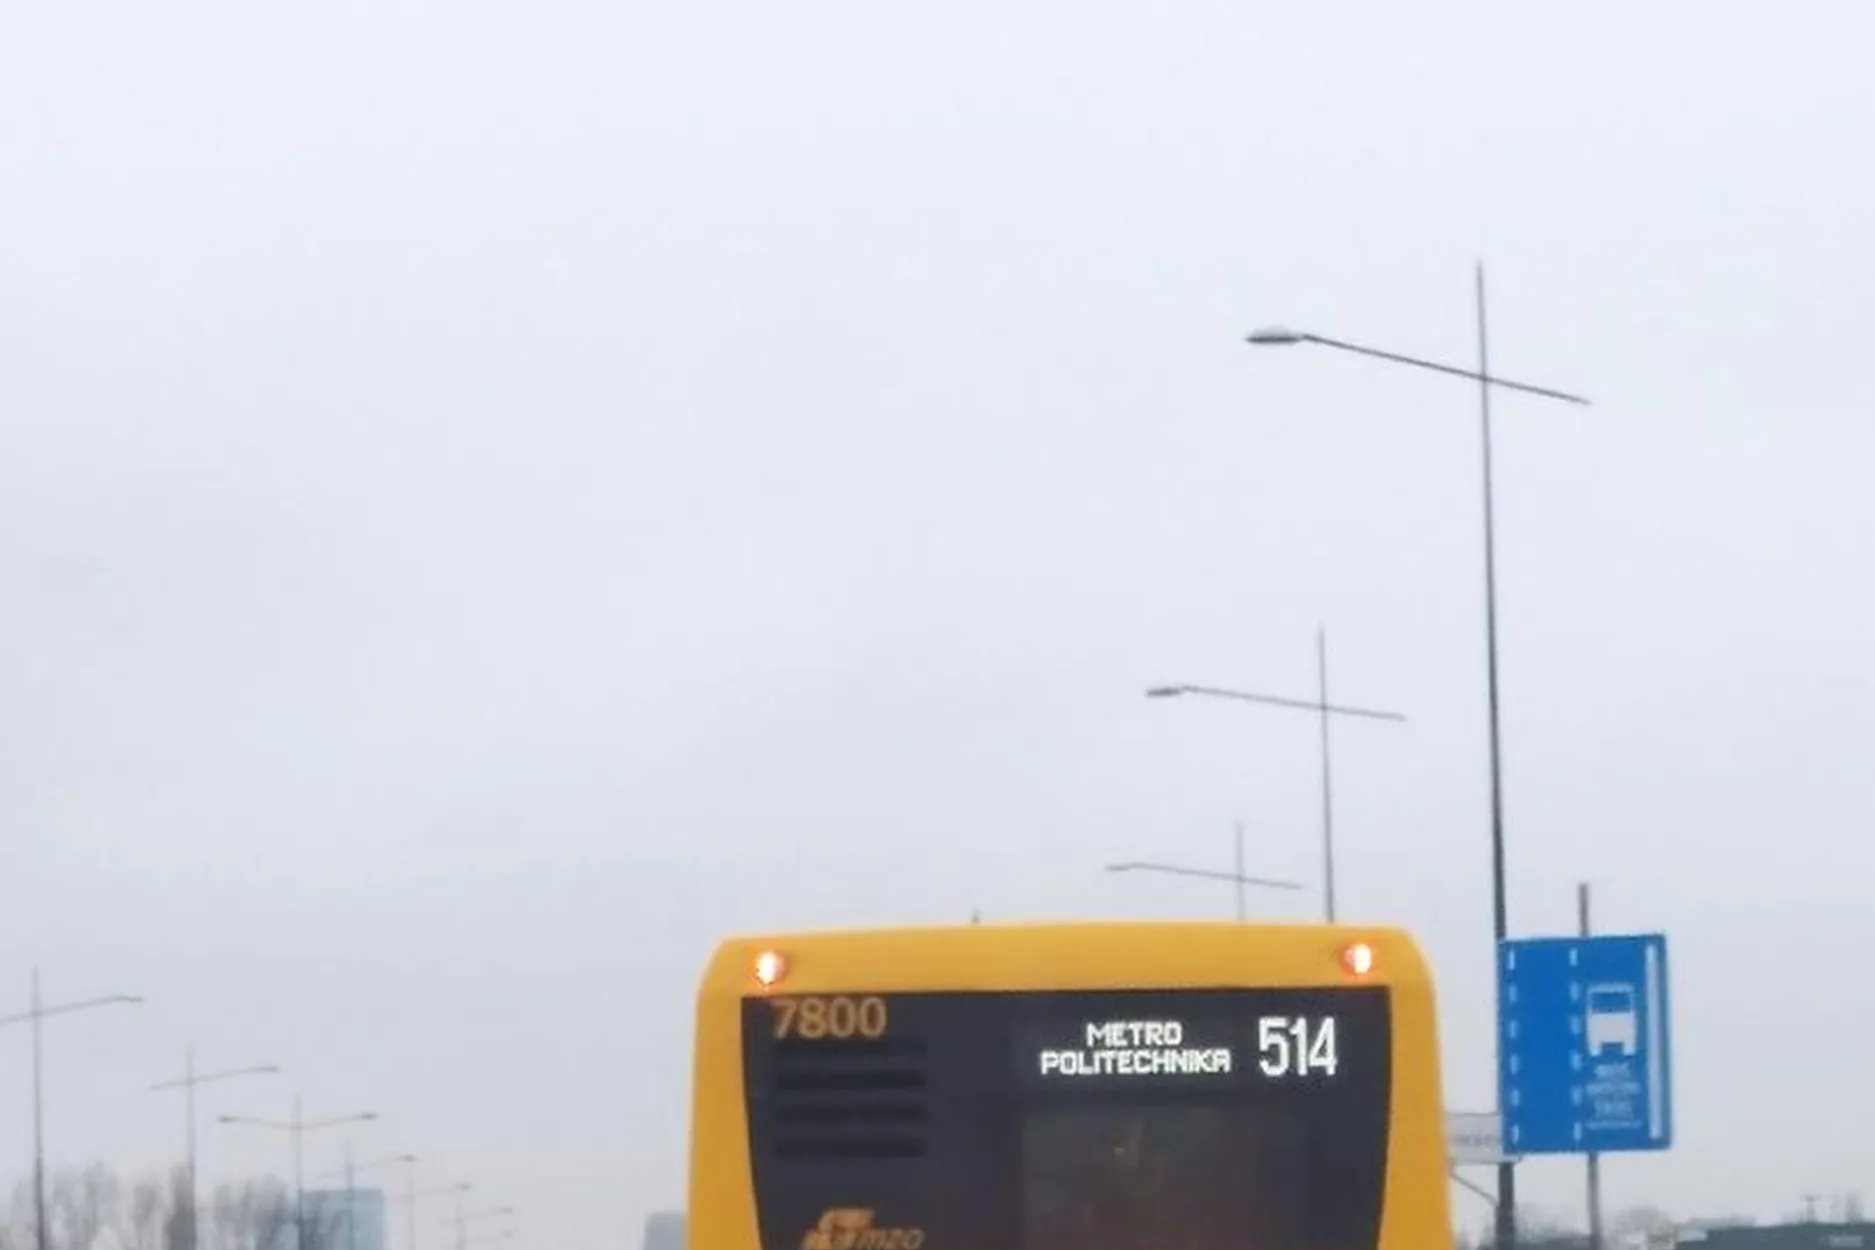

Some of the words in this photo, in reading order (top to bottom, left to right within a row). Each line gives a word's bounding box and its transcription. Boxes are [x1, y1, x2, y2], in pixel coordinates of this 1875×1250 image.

[770, 997, 886, 1038] 7800
[1086, 1021, 1182, 1047] METRO
[1041, 1049, 1231, 1075] POLITECHNIKA
[1258, 1016, 1337, 1076] 514
